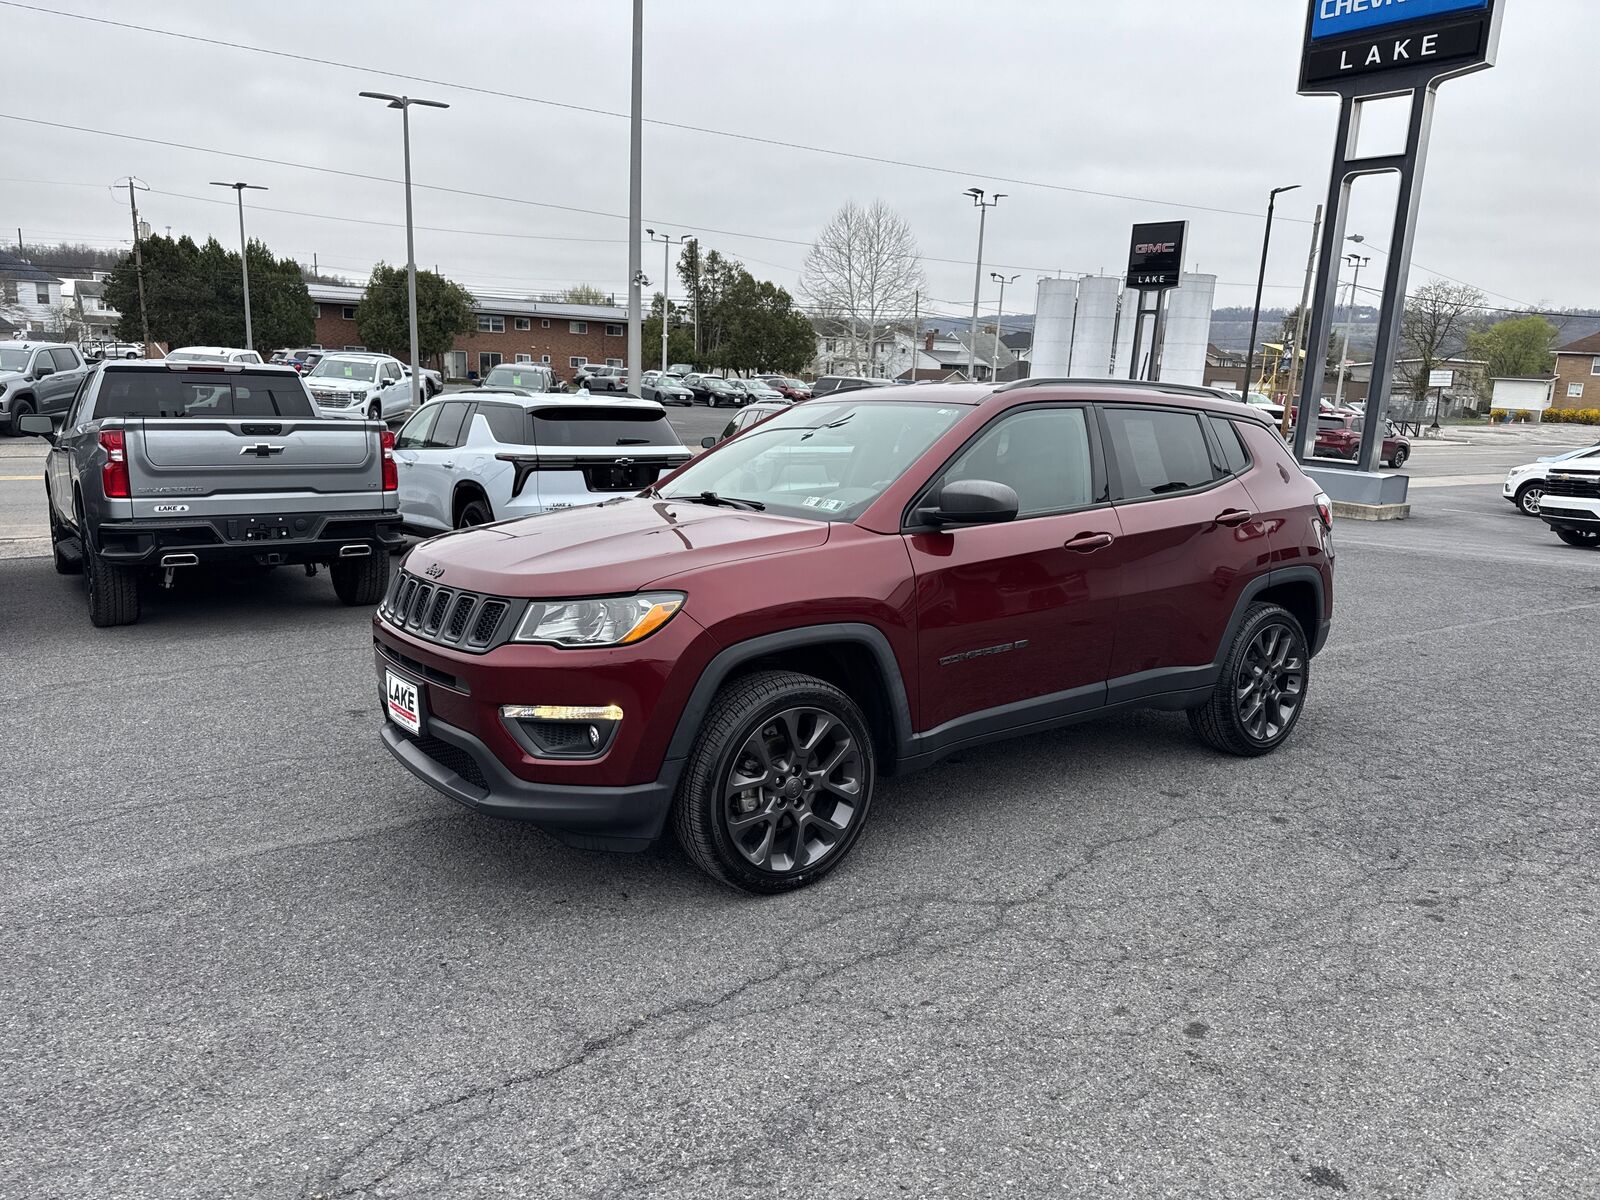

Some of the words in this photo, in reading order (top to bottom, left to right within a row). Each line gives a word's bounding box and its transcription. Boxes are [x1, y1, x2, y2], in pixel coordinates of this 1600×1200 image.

[1320, 0, 1408, 20] CHE
[1339, 33, 1439, 70] LAKE
[1135, 242, 1175, 254] GMC
[1138, 275, 1165, 283] LAKE
[388, 679, 415, 713] LAKE
